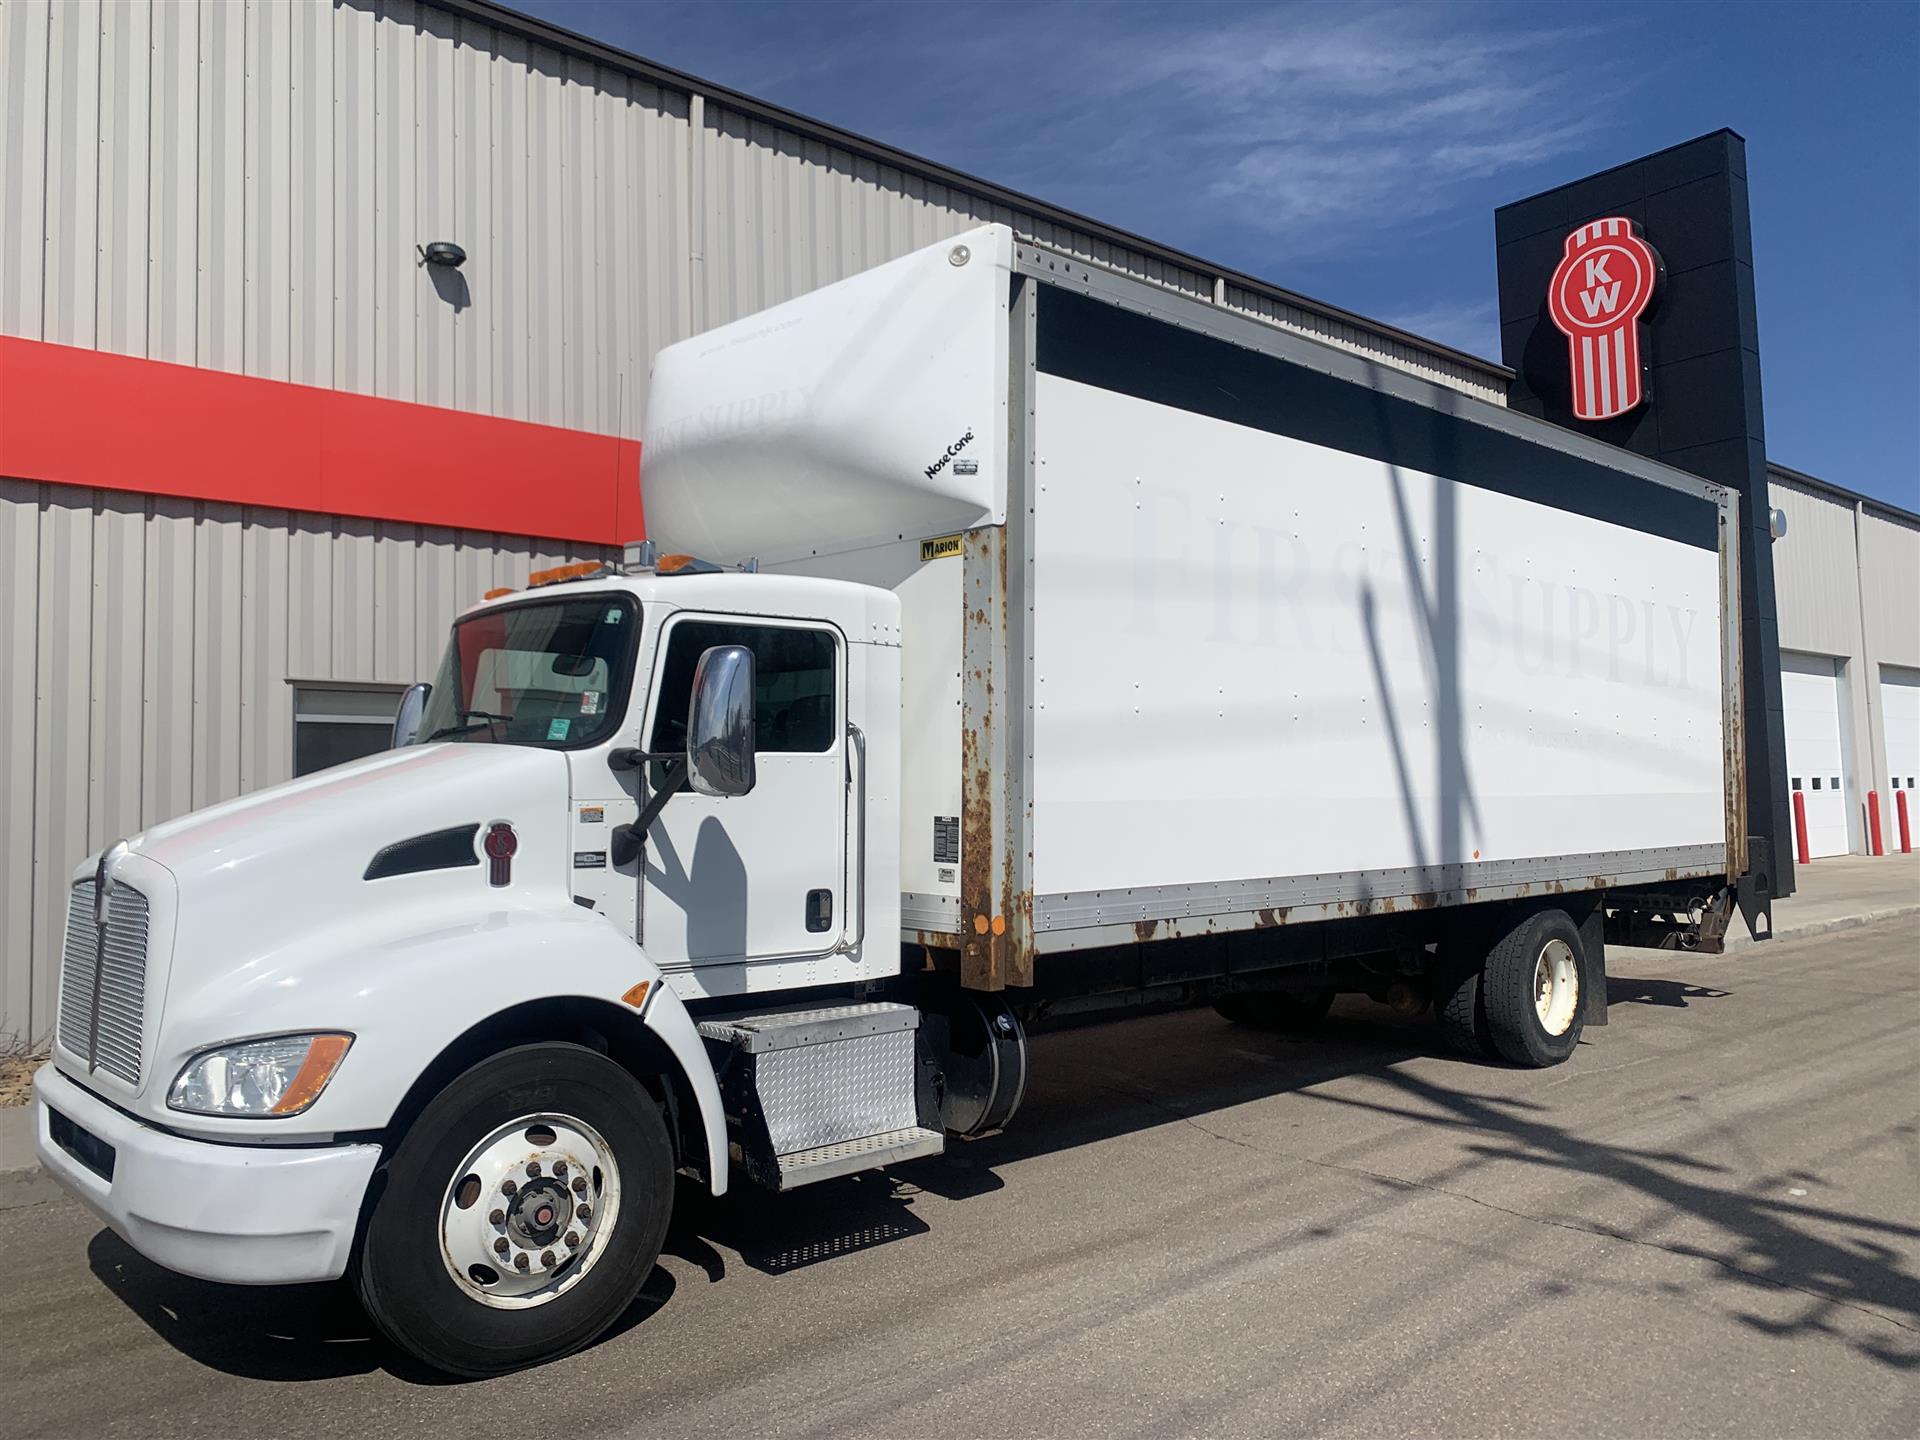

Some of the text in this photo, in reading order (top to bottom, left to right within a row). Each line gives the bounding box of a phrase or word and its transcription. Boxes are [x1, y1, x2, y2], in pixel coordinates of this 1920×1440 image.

[922, 540, 959, 559] MARION
[1121, 479, 1699, 691] FIRST SUPPLY
